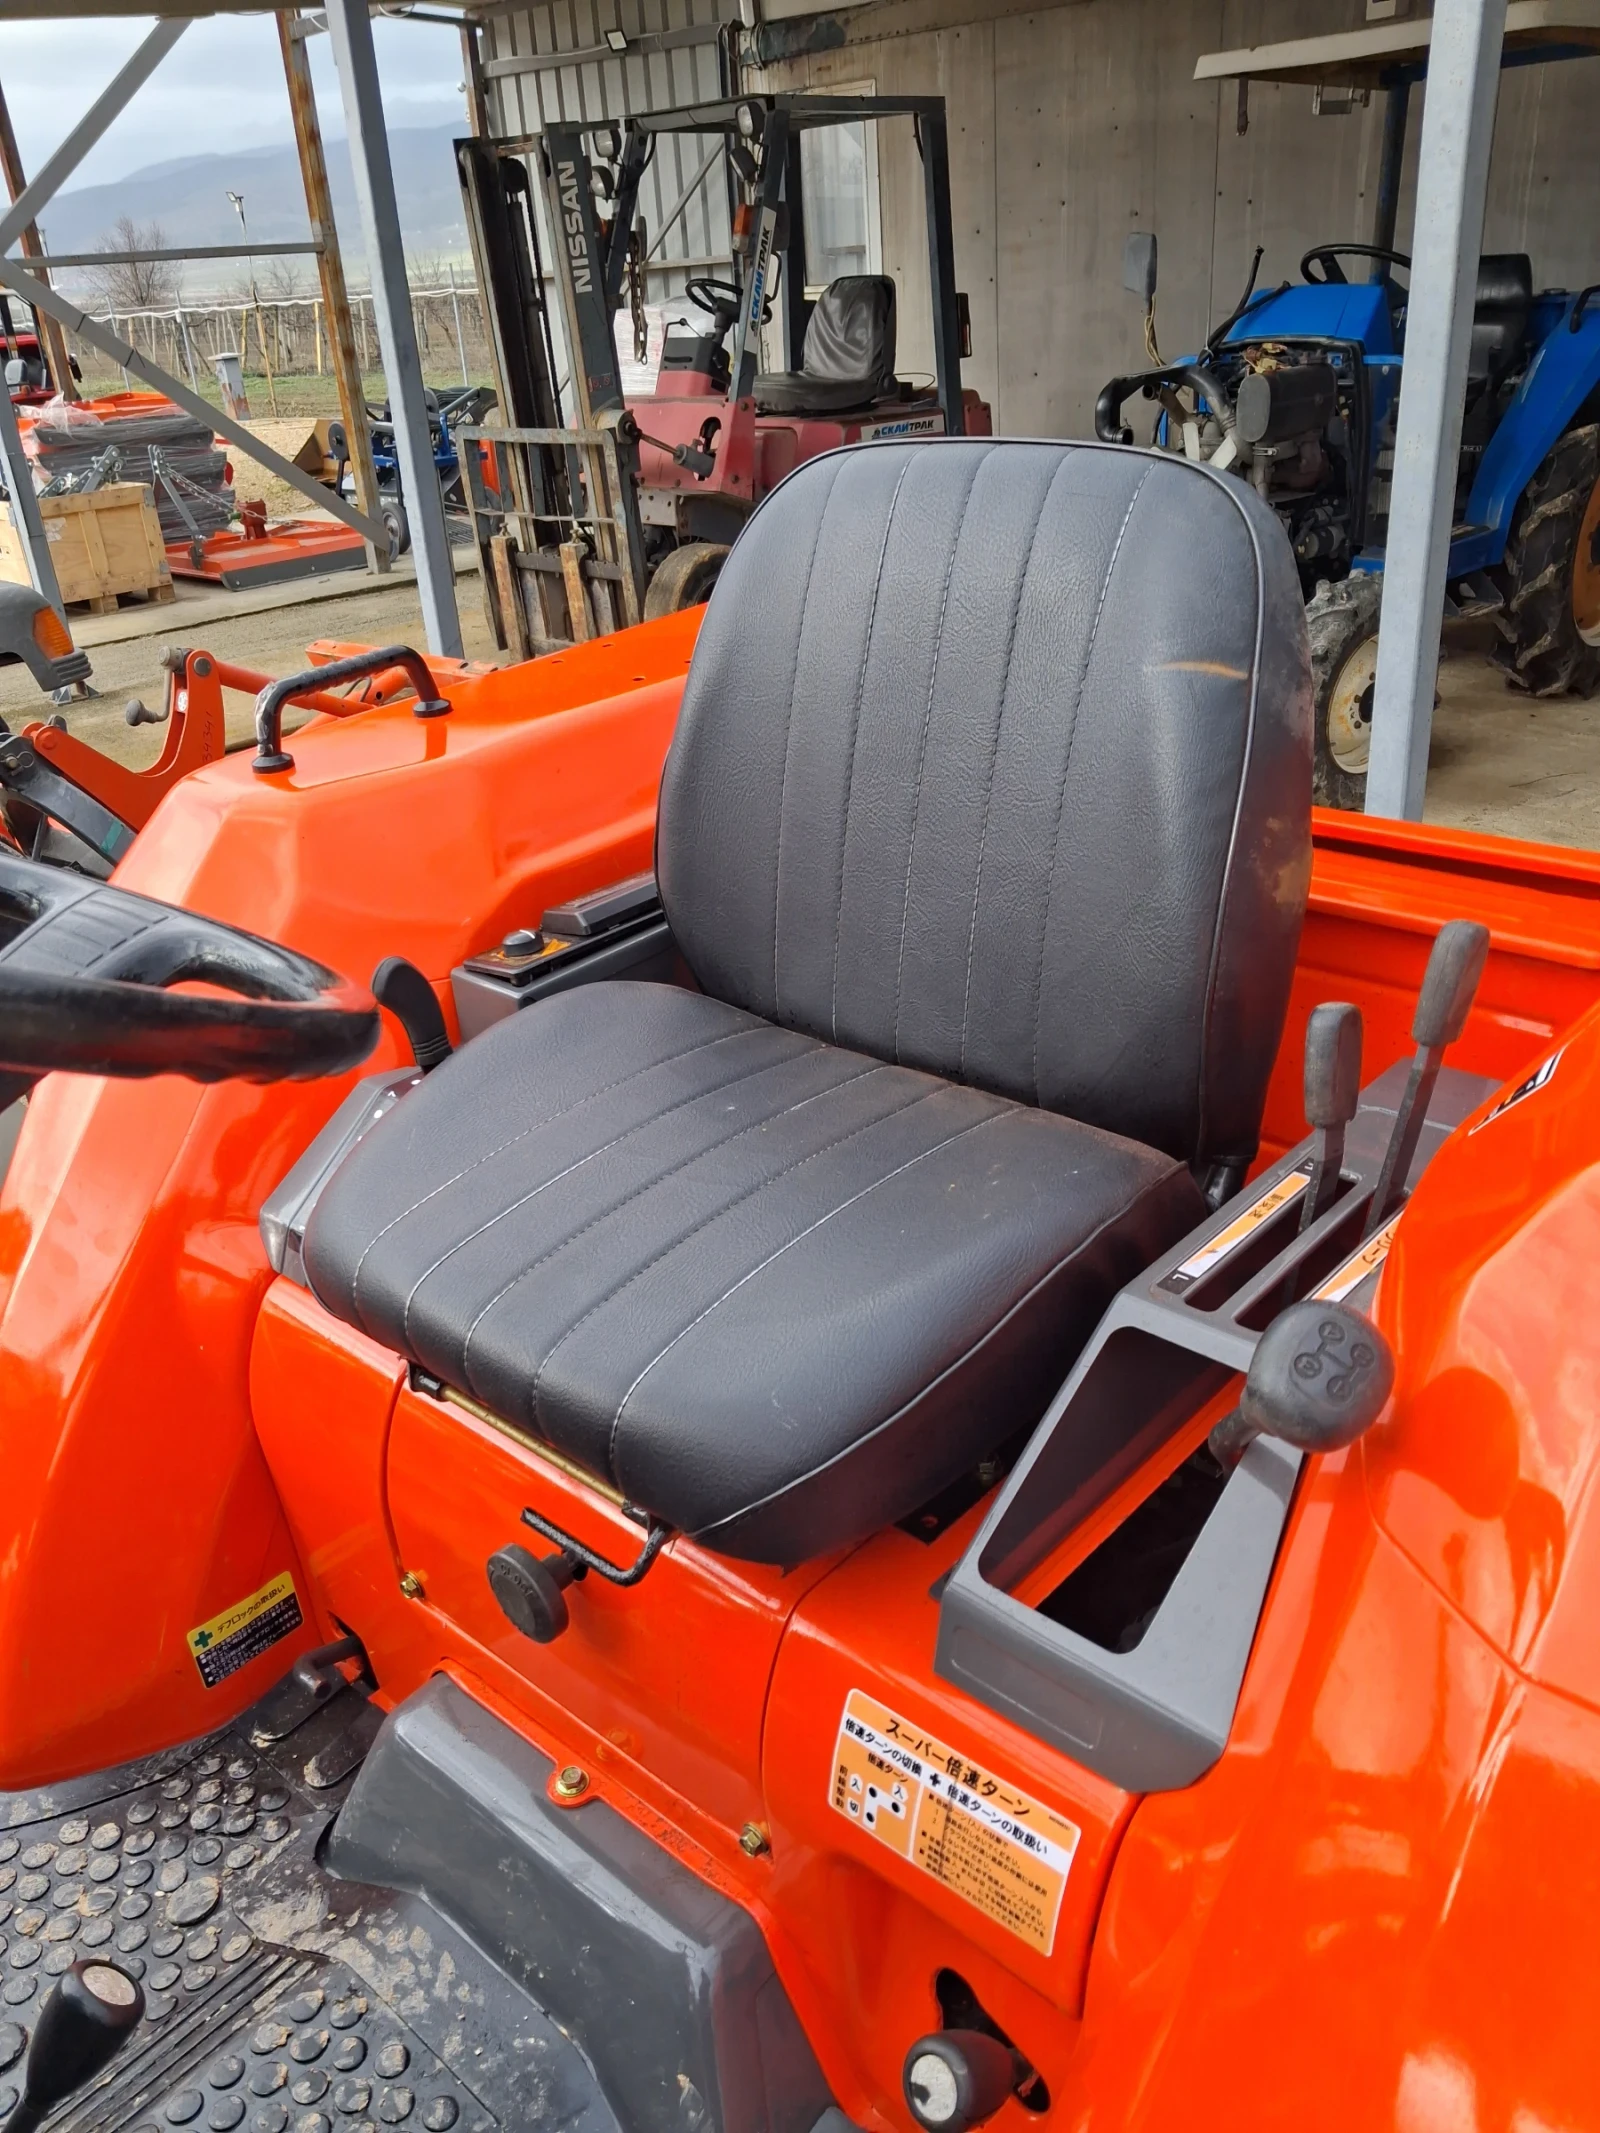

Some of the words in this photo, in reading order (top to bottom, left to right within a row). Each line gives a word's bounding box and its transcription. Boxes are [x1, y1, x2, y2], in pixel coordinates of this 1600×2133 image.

[557, 160, 593, 294] NISSAN
[217, 1583, 287, 1634] デフロックの取扱い
[845, 1717, 923, 1778] 倍速ターンの切換
[867, 1752, 909, 1783] 倍速ターン
[885, 1717, 1031, 1817] スーパー倍速ターン
[849, 1800, 859, 1813] 切
[851, 1778, 861, 1792] 入
[893, 1785, 904, 1800] 入
[947, 1784, 1049, 1855] 倍速ターンの取扱い
